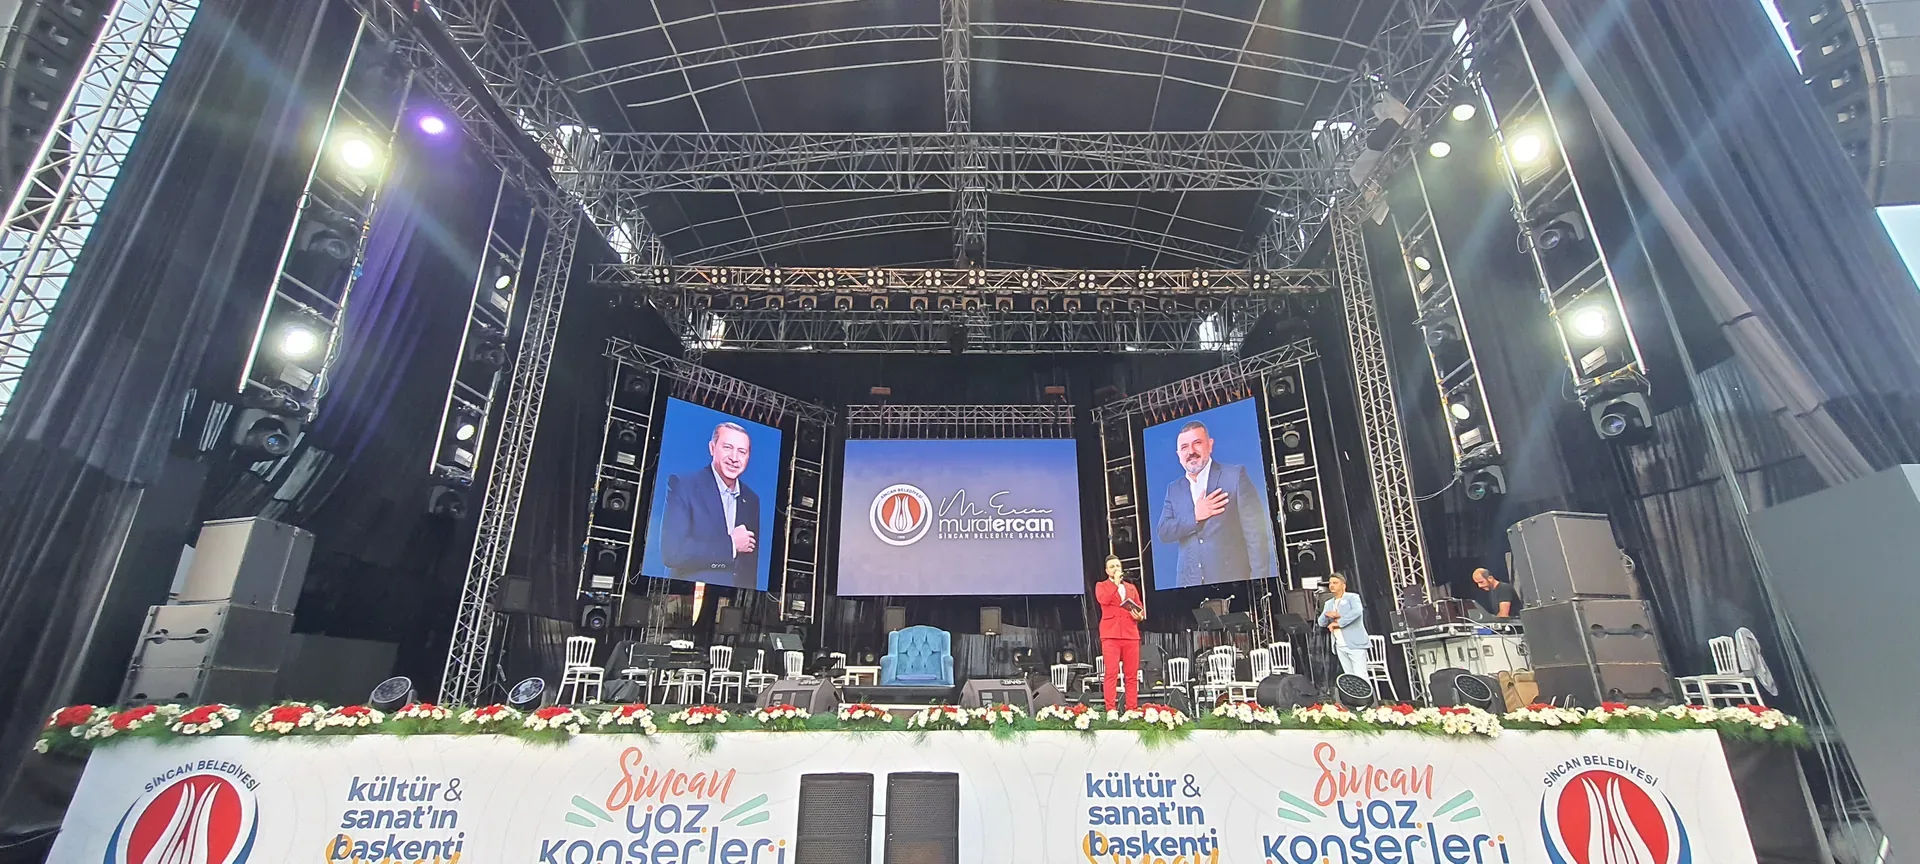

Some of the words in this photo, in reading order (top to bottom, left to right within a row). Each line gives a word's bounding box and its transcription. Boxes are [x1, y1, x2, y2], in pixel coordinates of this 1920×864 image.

[144, 762, 194, 793] SİNCAN
[197, 759, 261, 792] BELEDİYESİ
[605, 746, 737, 812] Sincan
[1085, 772, 1177, 798] kültür
[1181, 773, 1202, 798] &
[1313, 742, 1434, 807] Sincan
[1543, 757, 1582, 788] SİNCAN
[1583, 755, 1659, 787] BELEDİYESİ
[347, 776, 442, 801] kültür
[443, 777, 463, 801] &
[340, 805, 458, 829] sanat'ın
[625, 804, 710, 841] yaz
[1088, 801, 1205, 825] sanat'ın
[1336, 800, 1419, 838] yaz
[330, 831, 465, 862] başkenti
[1088, 827, 1219, 858] başkenti
